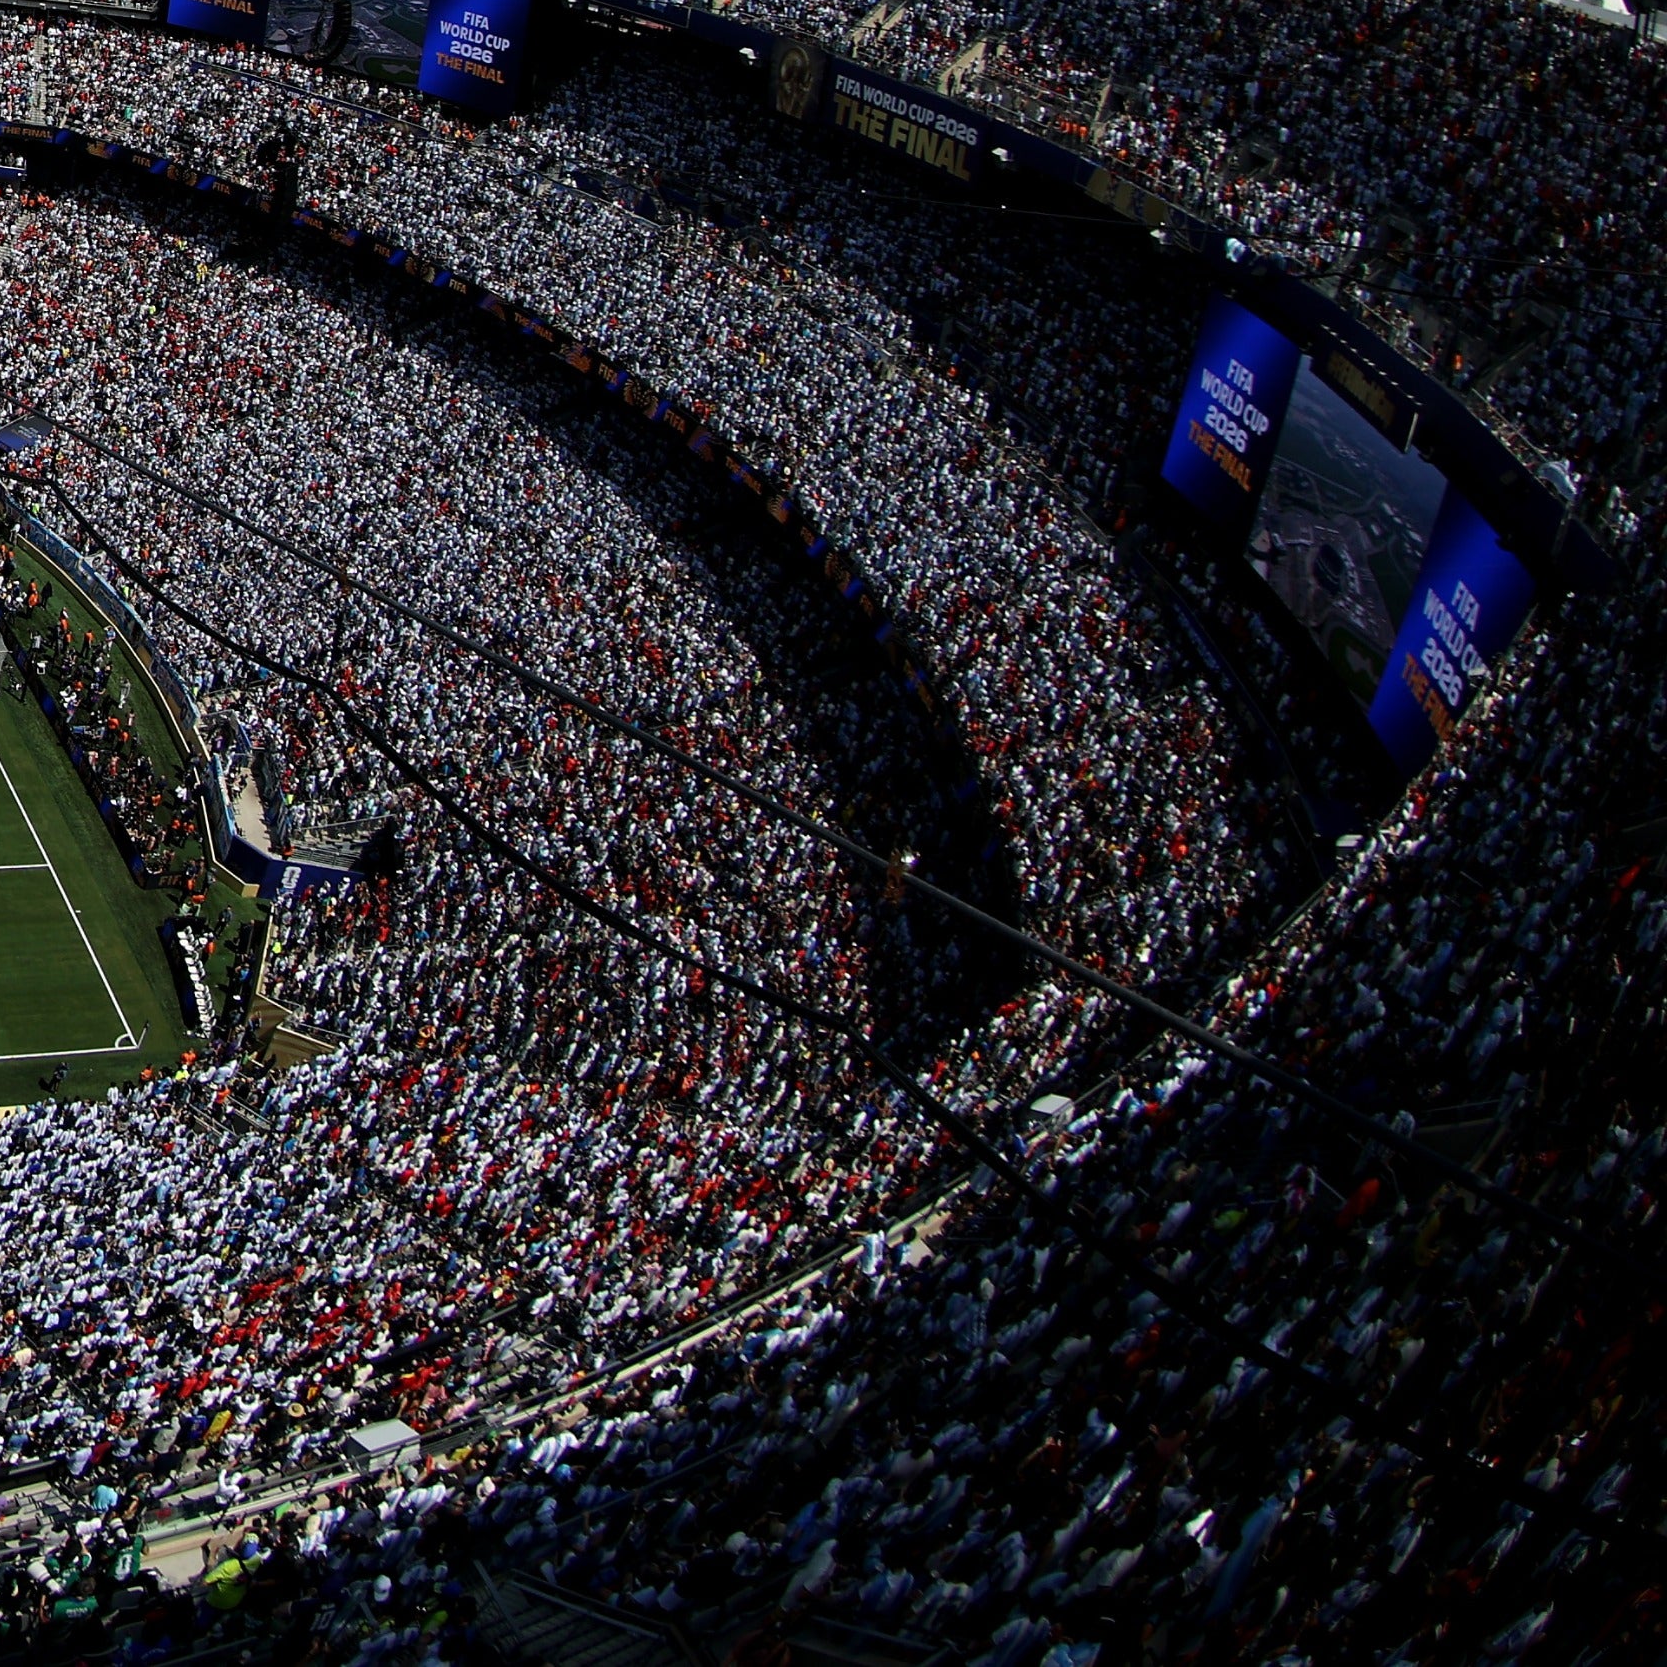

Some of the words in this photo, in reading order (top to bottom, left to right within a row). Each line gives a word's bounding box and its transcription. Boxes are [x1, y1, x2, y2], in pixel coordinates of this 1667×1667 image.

[439, 20, 484, 44] WORLD
[484, 33, 511, 52] CUP
[463, 11, 490, 30] FIFA
[436, 51, 463, 74] THE
[463, 58, 506, 85] FINAL
[449, 39, 494, 64] 2026
[835, 74, 861, 99] FIFA
[863, 83, 908, 116] WORLD
[907, 103, 935, 126] CUP
[934, 114, 978, 147] 2026
[1, 125, 24, 135] THE
[24, 127, 54, 139] FINAL
[833, 93, 888, 143] THE
[888, 116, 972, 182] FINAL
[132, 155, 151, 167] FIFA
[212, 181, 231, 195] FIFA
[449, 278, 467, 295] FIFA
[1225, 357, 1255, 396] FIFA
[1199, 366, 1244, 418] WORLD
[1241, 399, 1271, 436] CUP
[1203, 405, 1248, 454] 2026
[1187, 418, 1215, 457] THE
[1211, 439, 1253, 494] FINAL
[1423, 587, 1467, 660] WORLD
[1450, 580, 1482, 633] FIFA
[1420, 637, 1464, 708] 2026
